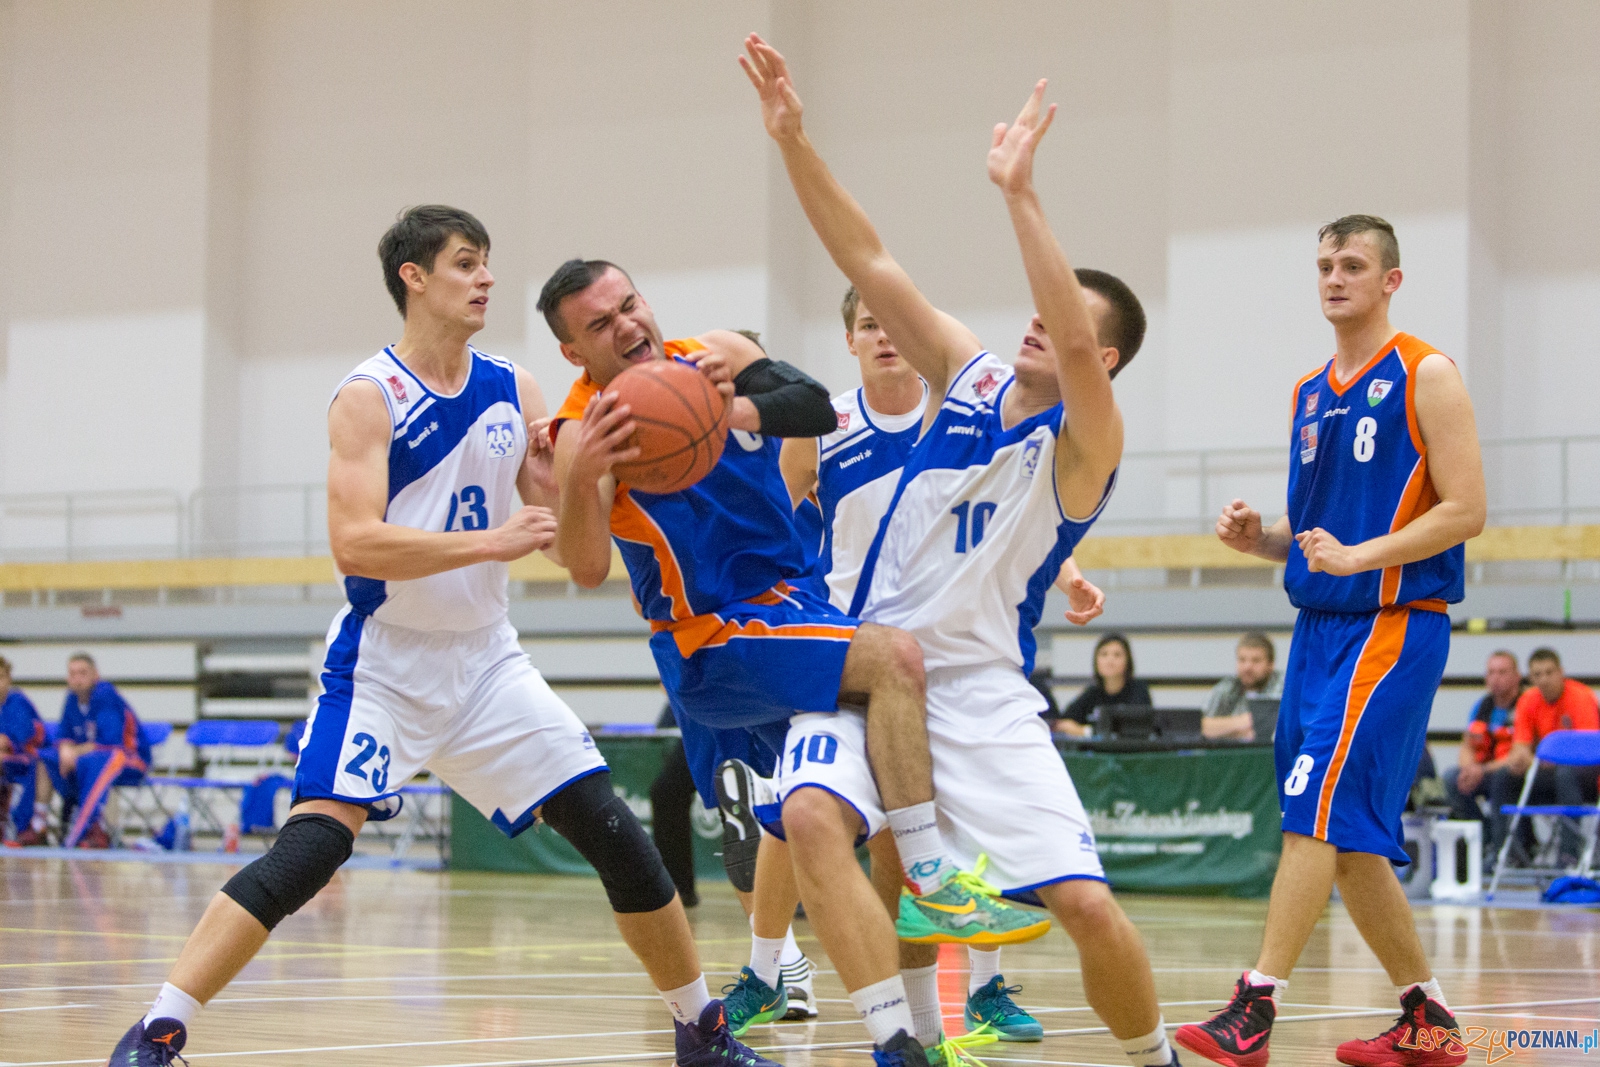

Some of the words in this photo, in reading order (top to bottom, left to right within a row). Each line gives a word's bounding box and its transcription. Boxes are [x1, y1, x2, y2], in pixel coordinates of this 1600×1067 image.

[839, 452, 864, 469] luanvi
[1353, 416, 1378, 463] 8
[951, 500, 998, 553] 10
[344, 732, 391, 794] 23
[790, 735, 838, 773] 10
[1284, 754, 1315, 796] 8
